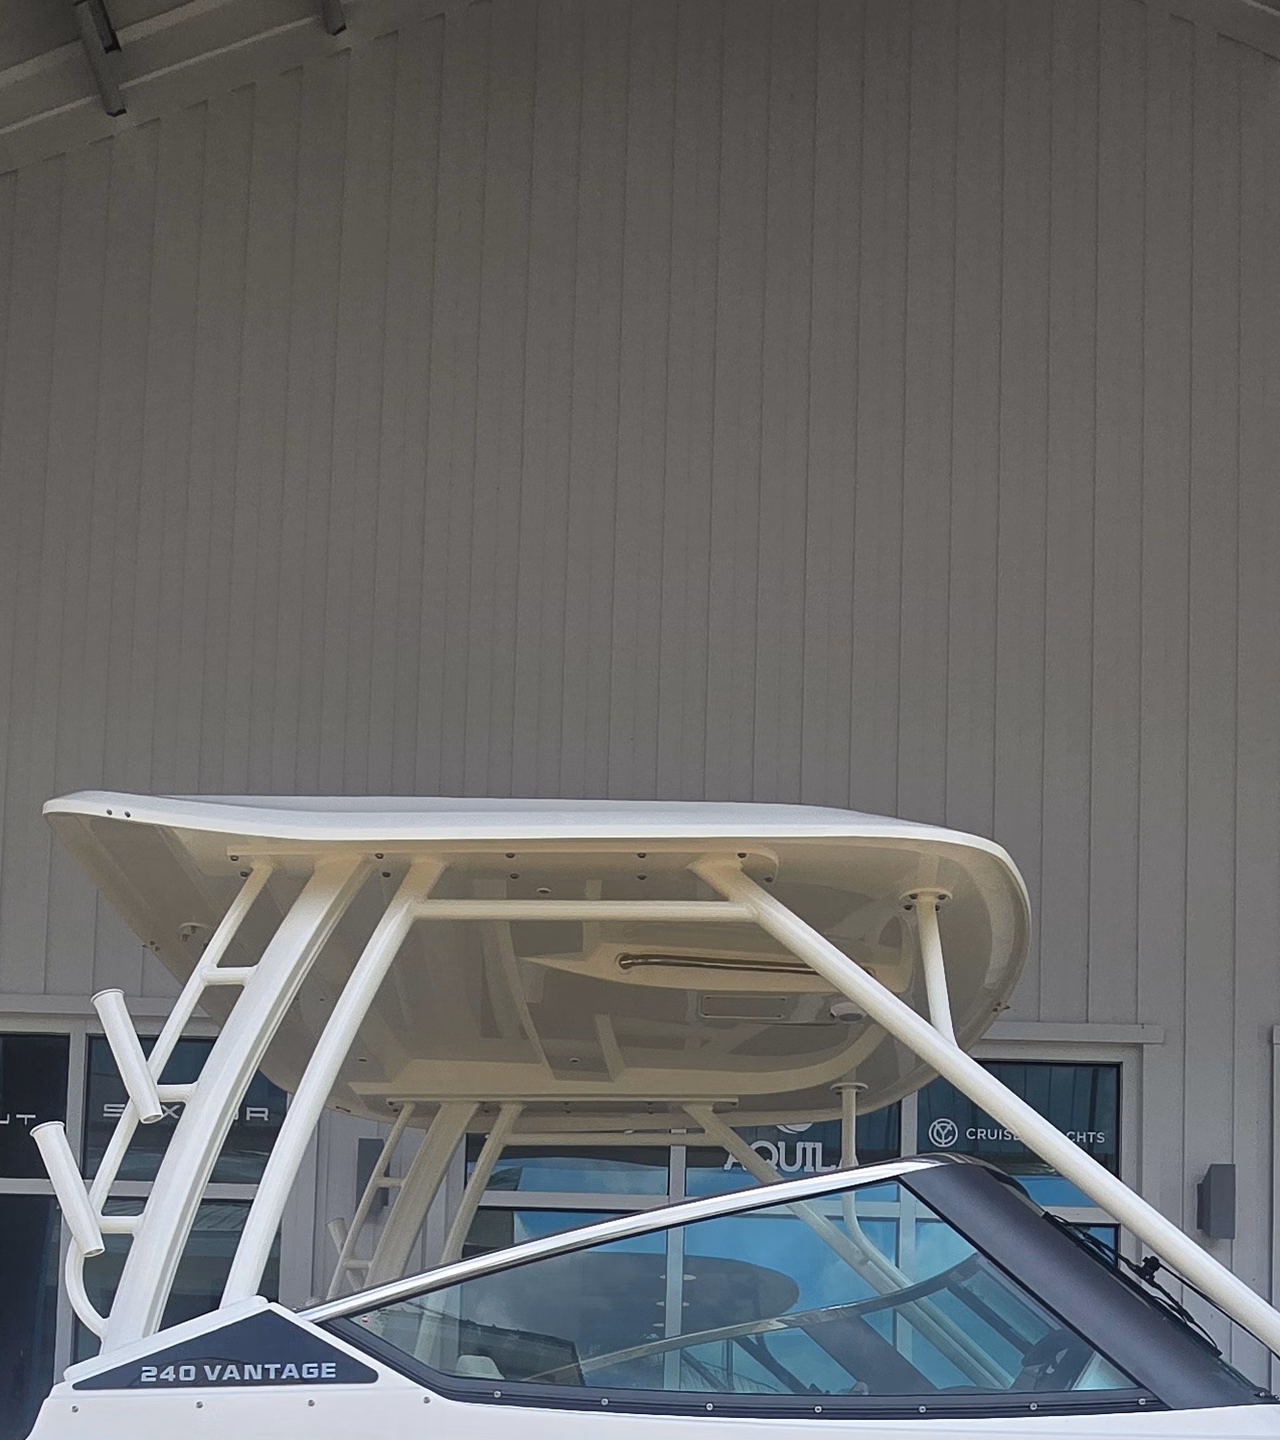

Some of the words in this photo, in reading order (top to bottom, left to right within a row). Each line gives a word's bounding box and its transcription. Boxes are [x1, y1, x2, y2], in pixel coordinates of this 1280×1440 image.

[103, 1103, 269, 1121] SXR
[966, 1127, 1022, 1141] CRUIS
[1065, 1131, 1106, 1144] CHTS
[724, 1140, 859, 1172] QUIL
[141, 1365, 196, 1382] 240
[203, 1362, 337, 1381] VANTAGE
